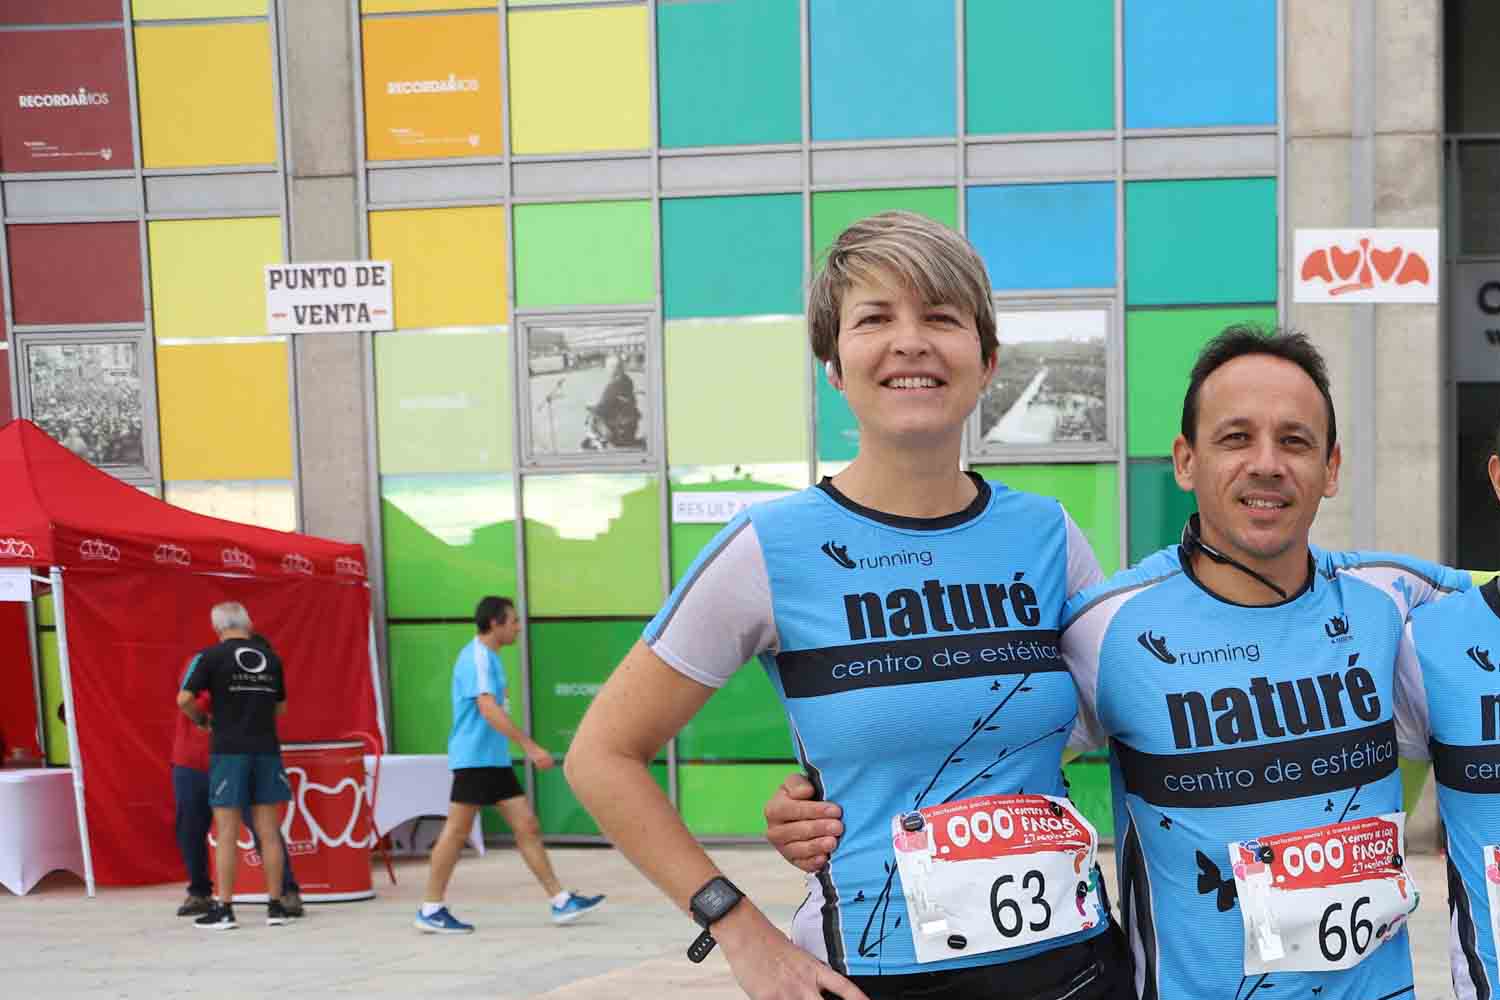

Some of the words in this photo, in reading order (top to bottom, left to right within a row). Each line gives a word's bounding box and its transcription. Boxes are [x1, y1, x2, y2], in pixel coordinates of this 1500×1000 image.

[269, 267, 347, 289] PUNTO
[355, 265, 385, 287] DE
[292, 302, 371, 325] VENTA
[859, 549, 933, 569] running
[843, 572, 1040, 640] naturé
[831, 652, 923, 679] centro
[932, 648, 971, 667] de
[1180, 644, 1260, 665] running
[1165, 653, 1381, 749] naturé
[1164, 769, 1254, 792] centro
[1264, 760, 1301, 784] de
[1311, 740, 1393, 776] estética
[1021, 816, 1074, 832] PASOS
[1352, 839, 1394, 861] PASOS
[990, 870, 1051, 937] 63
[1318, 896, 1373, 961] 66
